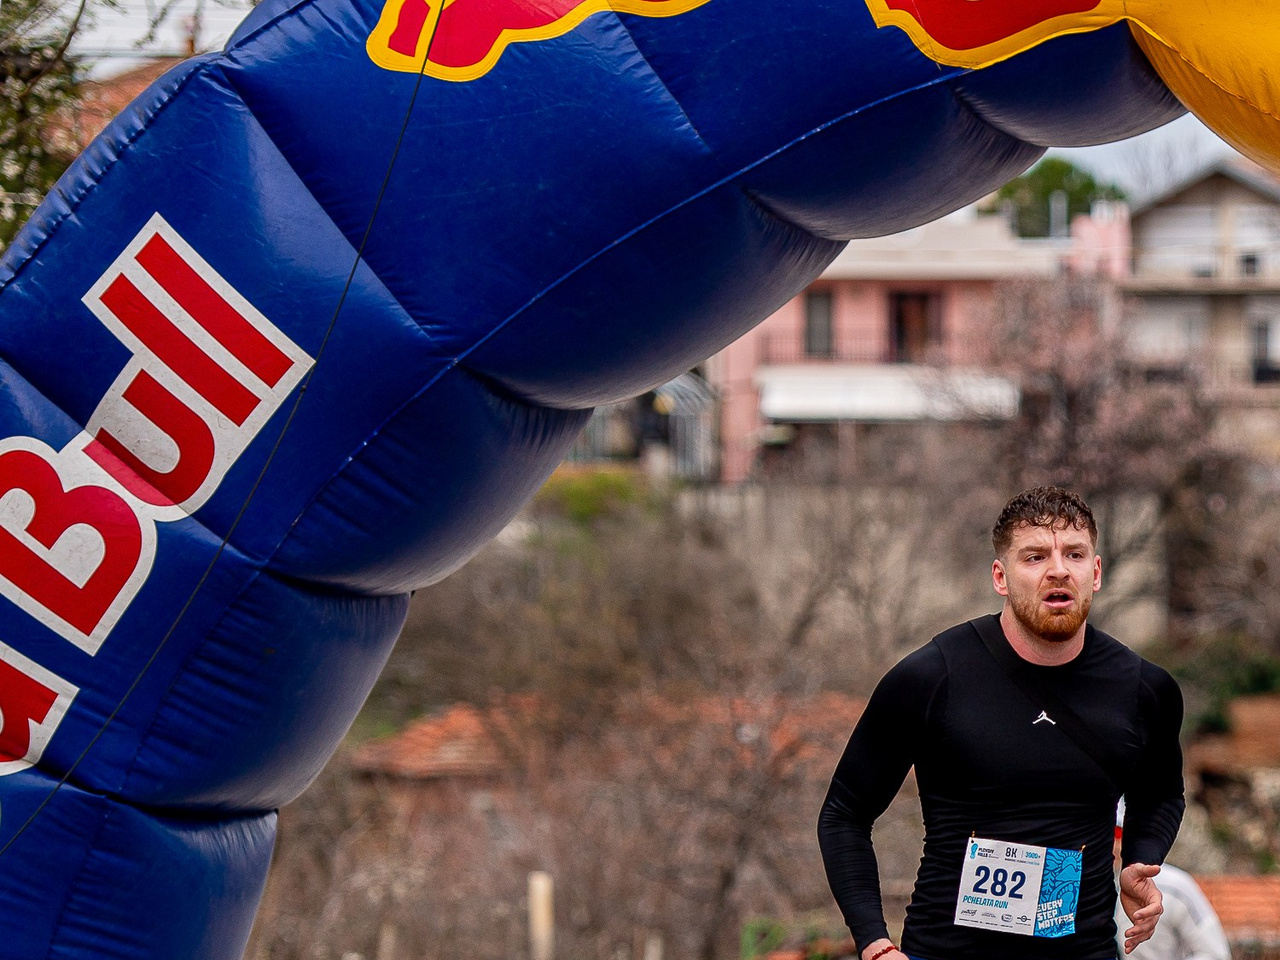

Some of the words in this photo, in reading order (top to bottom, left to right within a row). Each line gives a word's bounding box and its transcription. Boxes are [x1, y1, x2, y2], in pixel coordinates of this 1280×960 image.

[0, 230, 296, 638] Bull
[1005, 847, 1018, 858] 8K
[972, 865, 1027, 899] 282
[994, 900, 1009, 909] RUN
[1037, 910, 1058, 922] STEP
